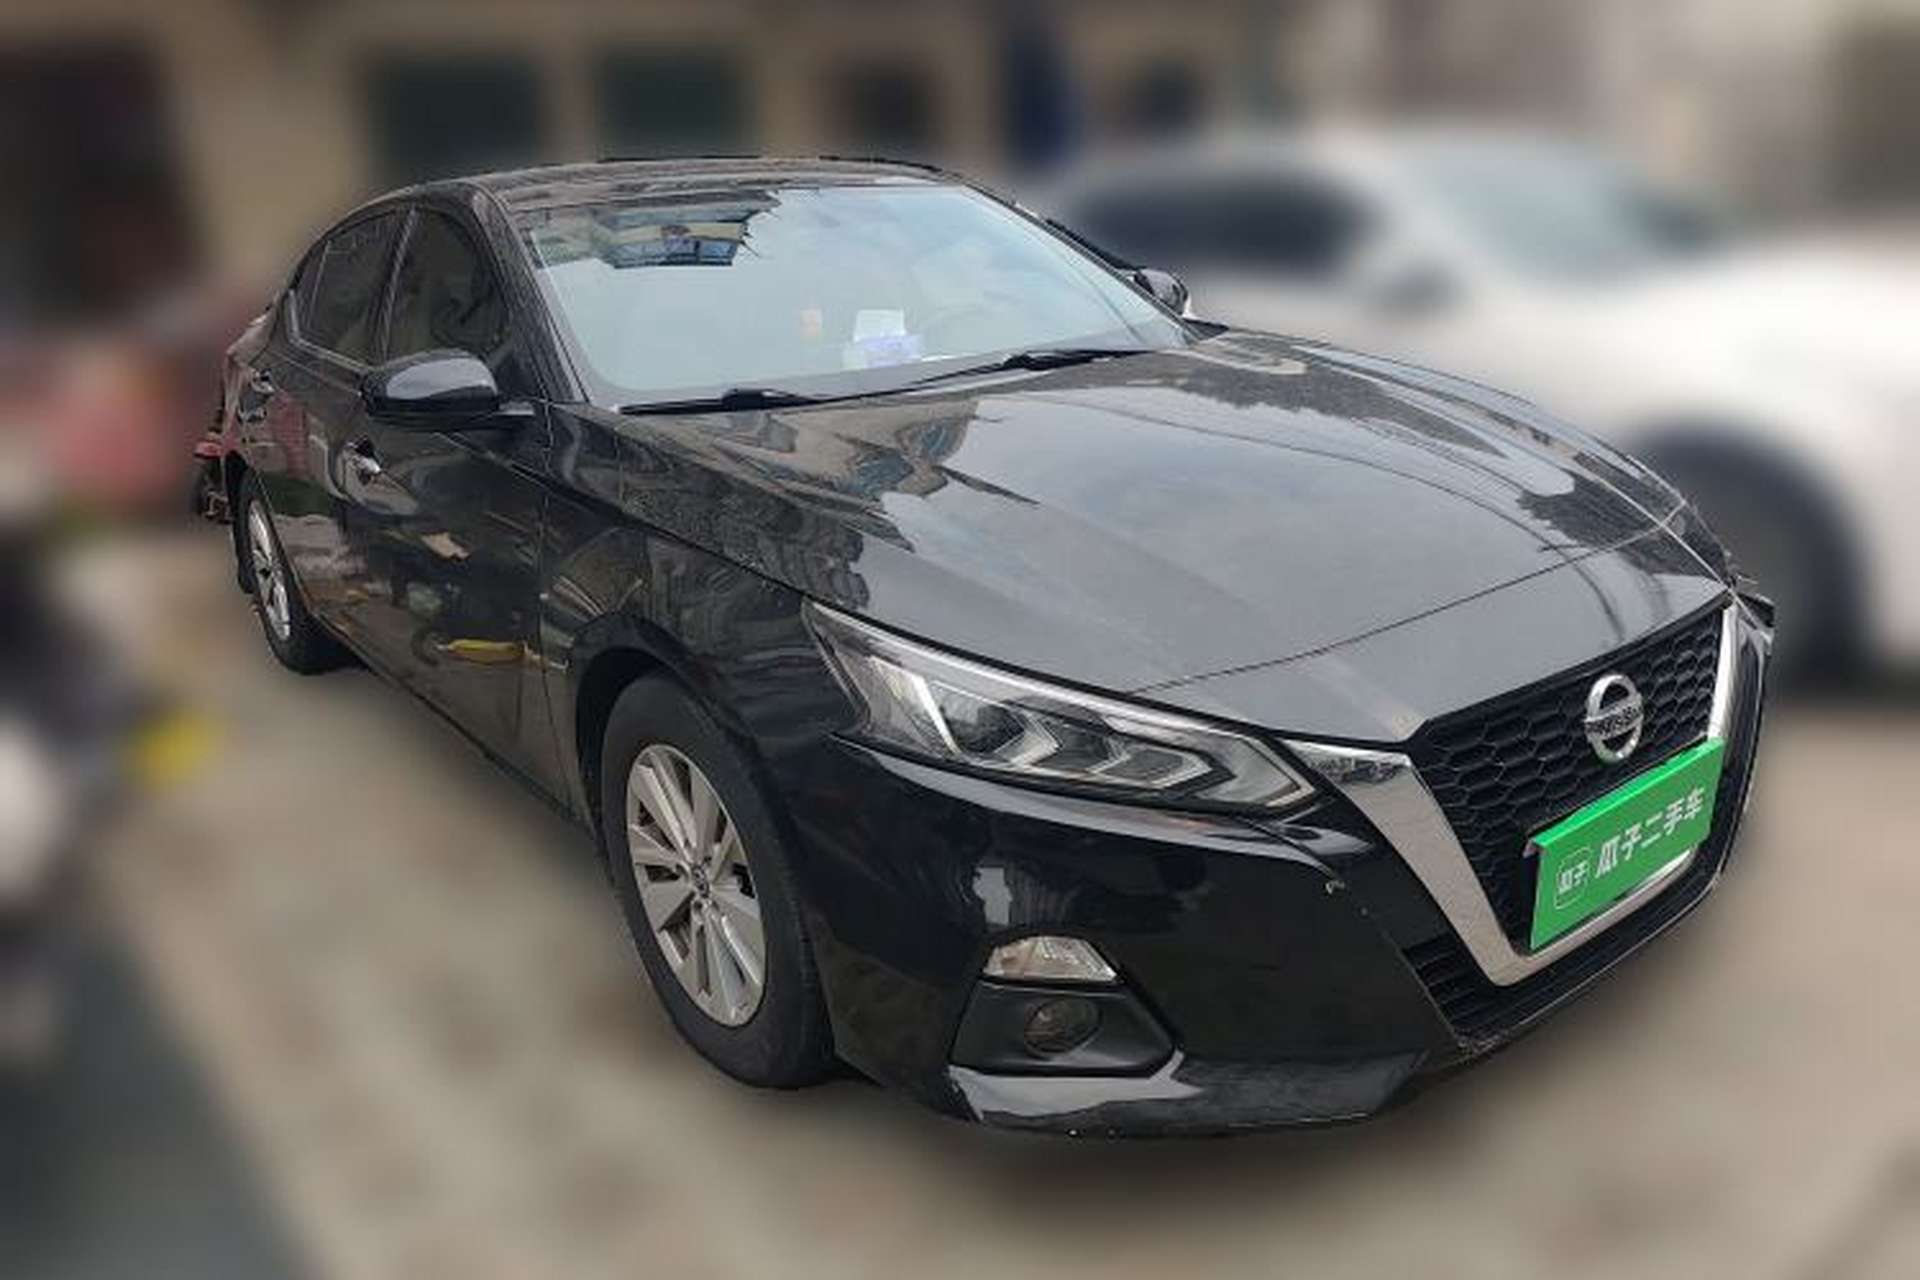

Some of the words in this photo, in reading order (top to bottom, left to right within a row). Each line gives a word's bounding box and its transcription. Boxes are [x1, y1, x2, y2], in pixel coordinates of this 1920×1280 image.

[1597, 788, 1704, 878] 瓜子二手车
